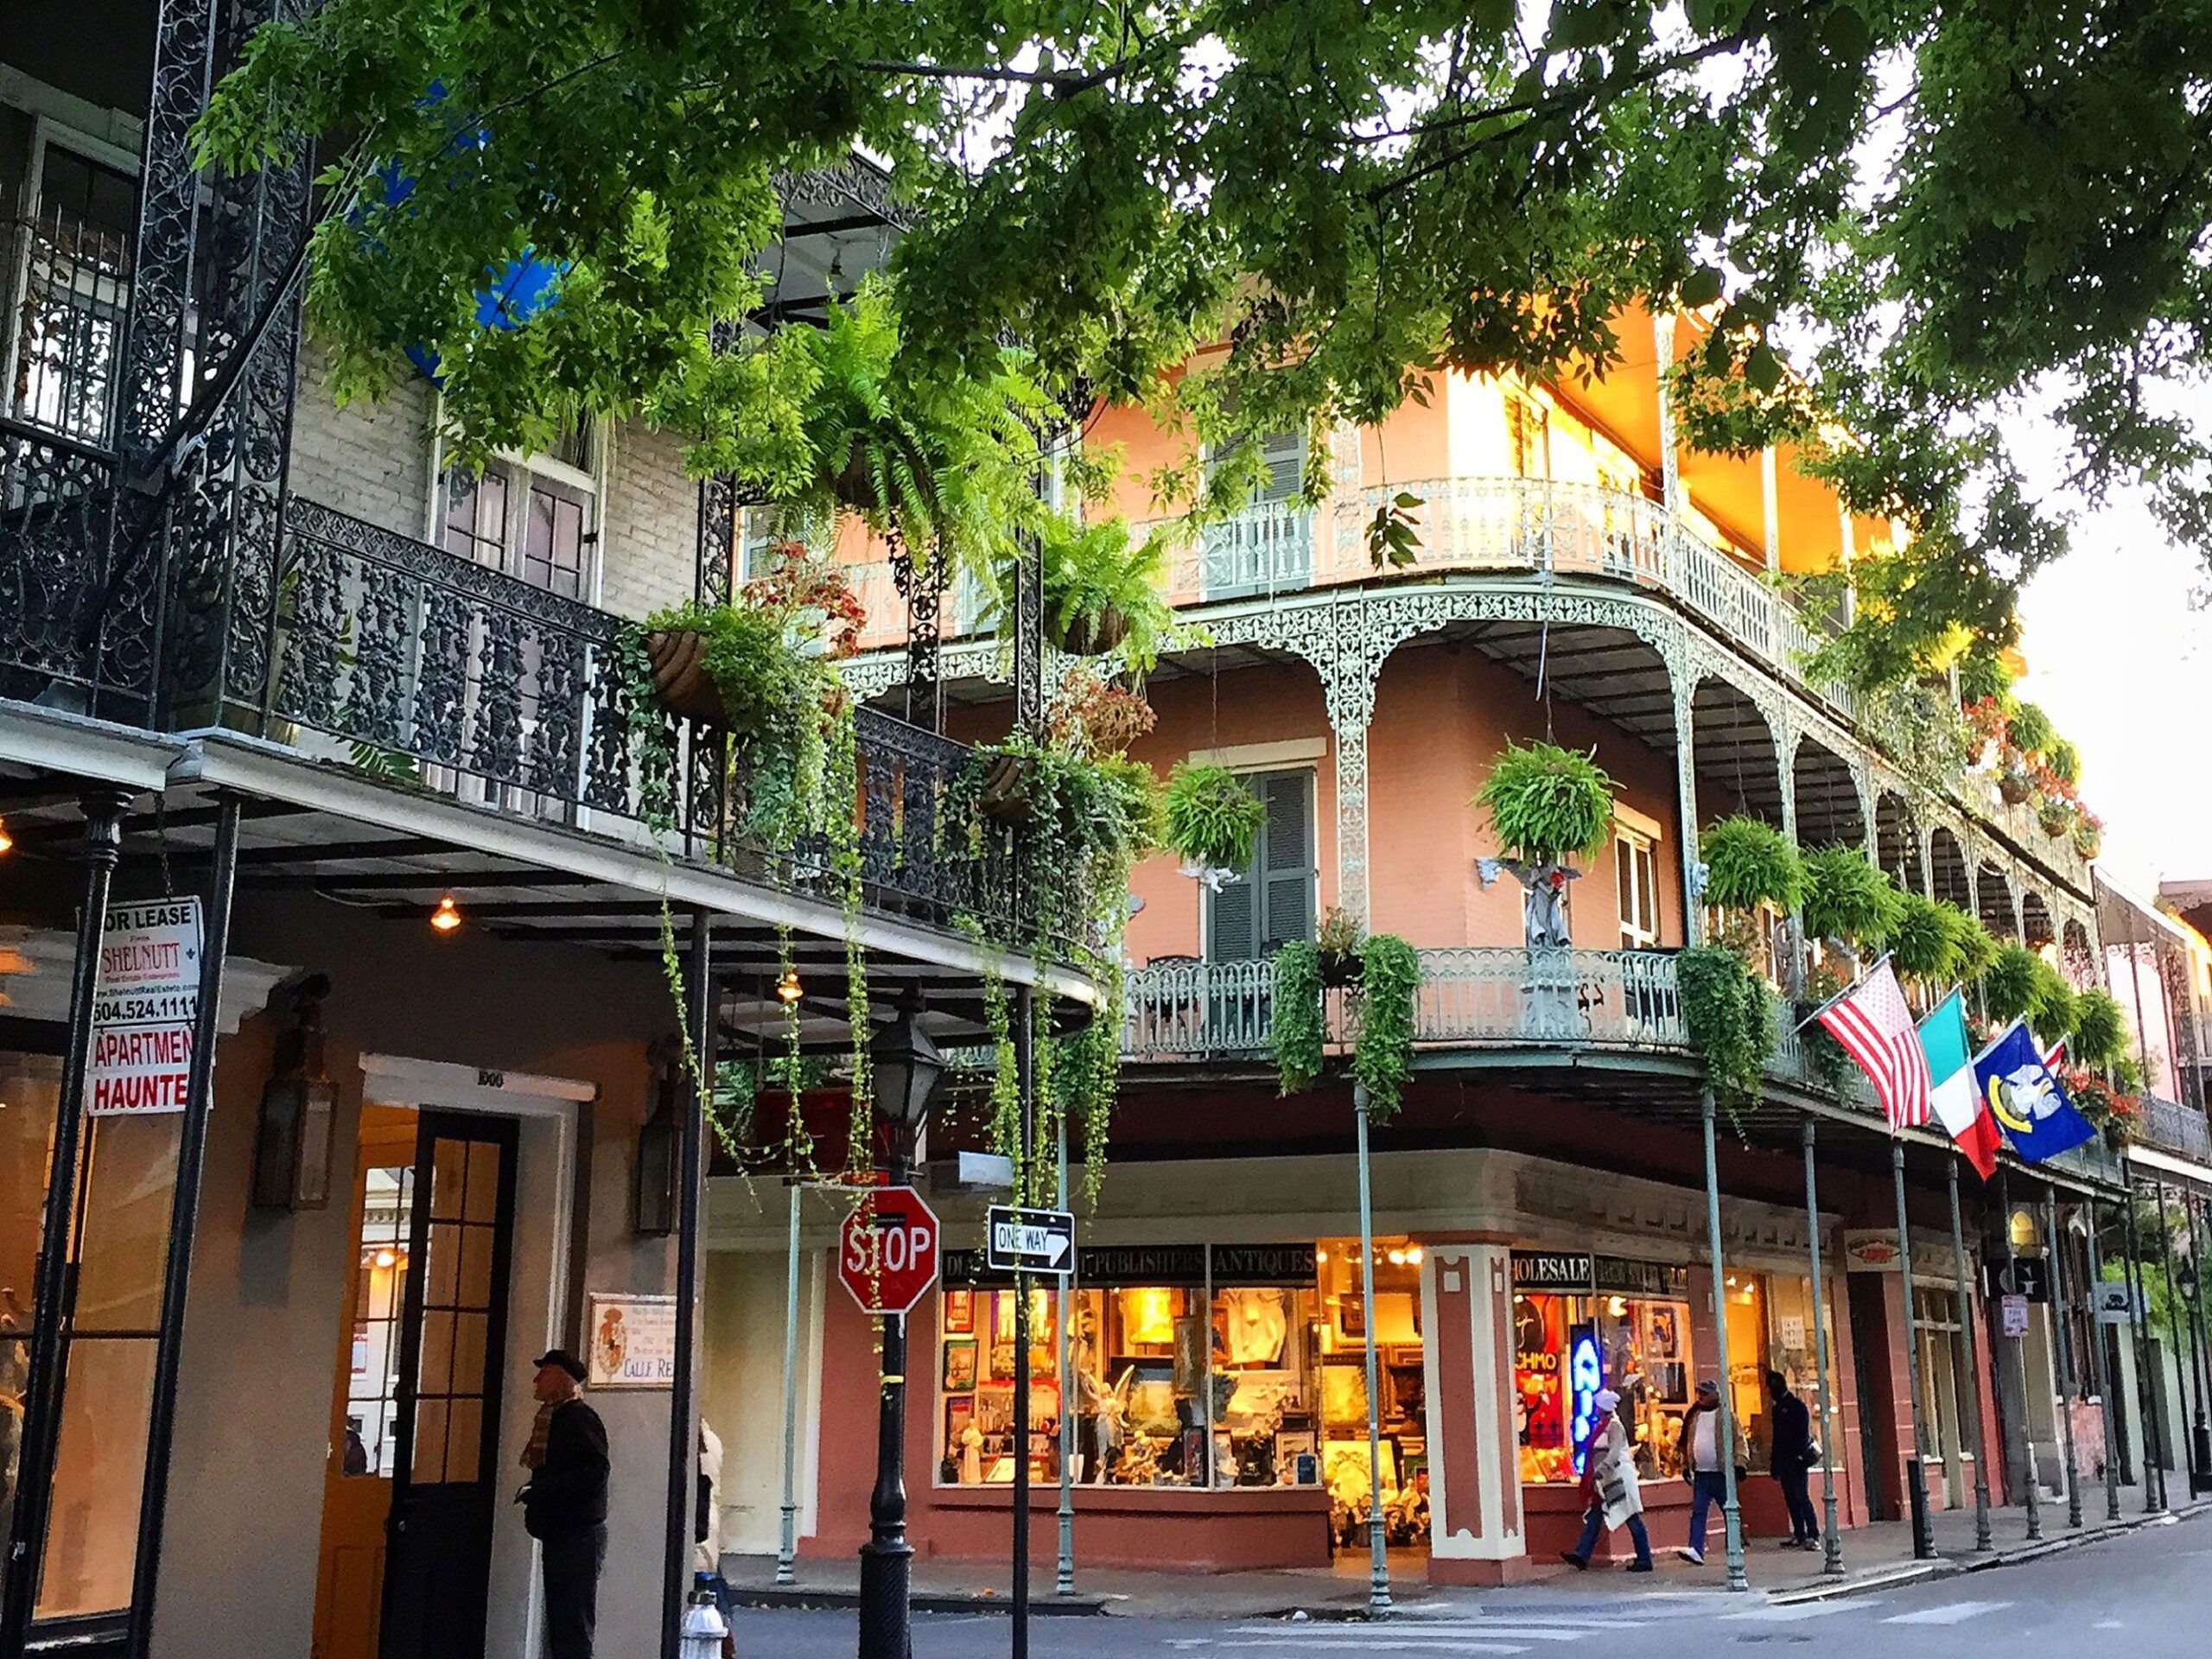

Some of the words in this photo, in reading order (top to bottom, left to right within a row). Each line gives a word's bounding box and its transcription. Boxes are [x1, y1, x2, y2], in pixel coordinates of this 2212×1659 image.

[104, 911, 130, 932] OR
[135, 906, 192, 929] LEASE
[102, 943, 180, 974] SHELNUTT
[94, 1029, 193, 1067] APARTMEN
[94, 1074, 189, 1110] HAUNTE
[846, 1225, 931, 1273] STOP
[998, 1226, 1021, 1249] ONE
[1026, 1229, 1049, 1252] WAY
[1214, 1250, 1315, 1275] ANTIQUES
[1512, 1257, 1590, 1281] HOLESALE
[658, 1358, 673, 1377] RE
[1515, 1351, 1557, 1370] CHMO
